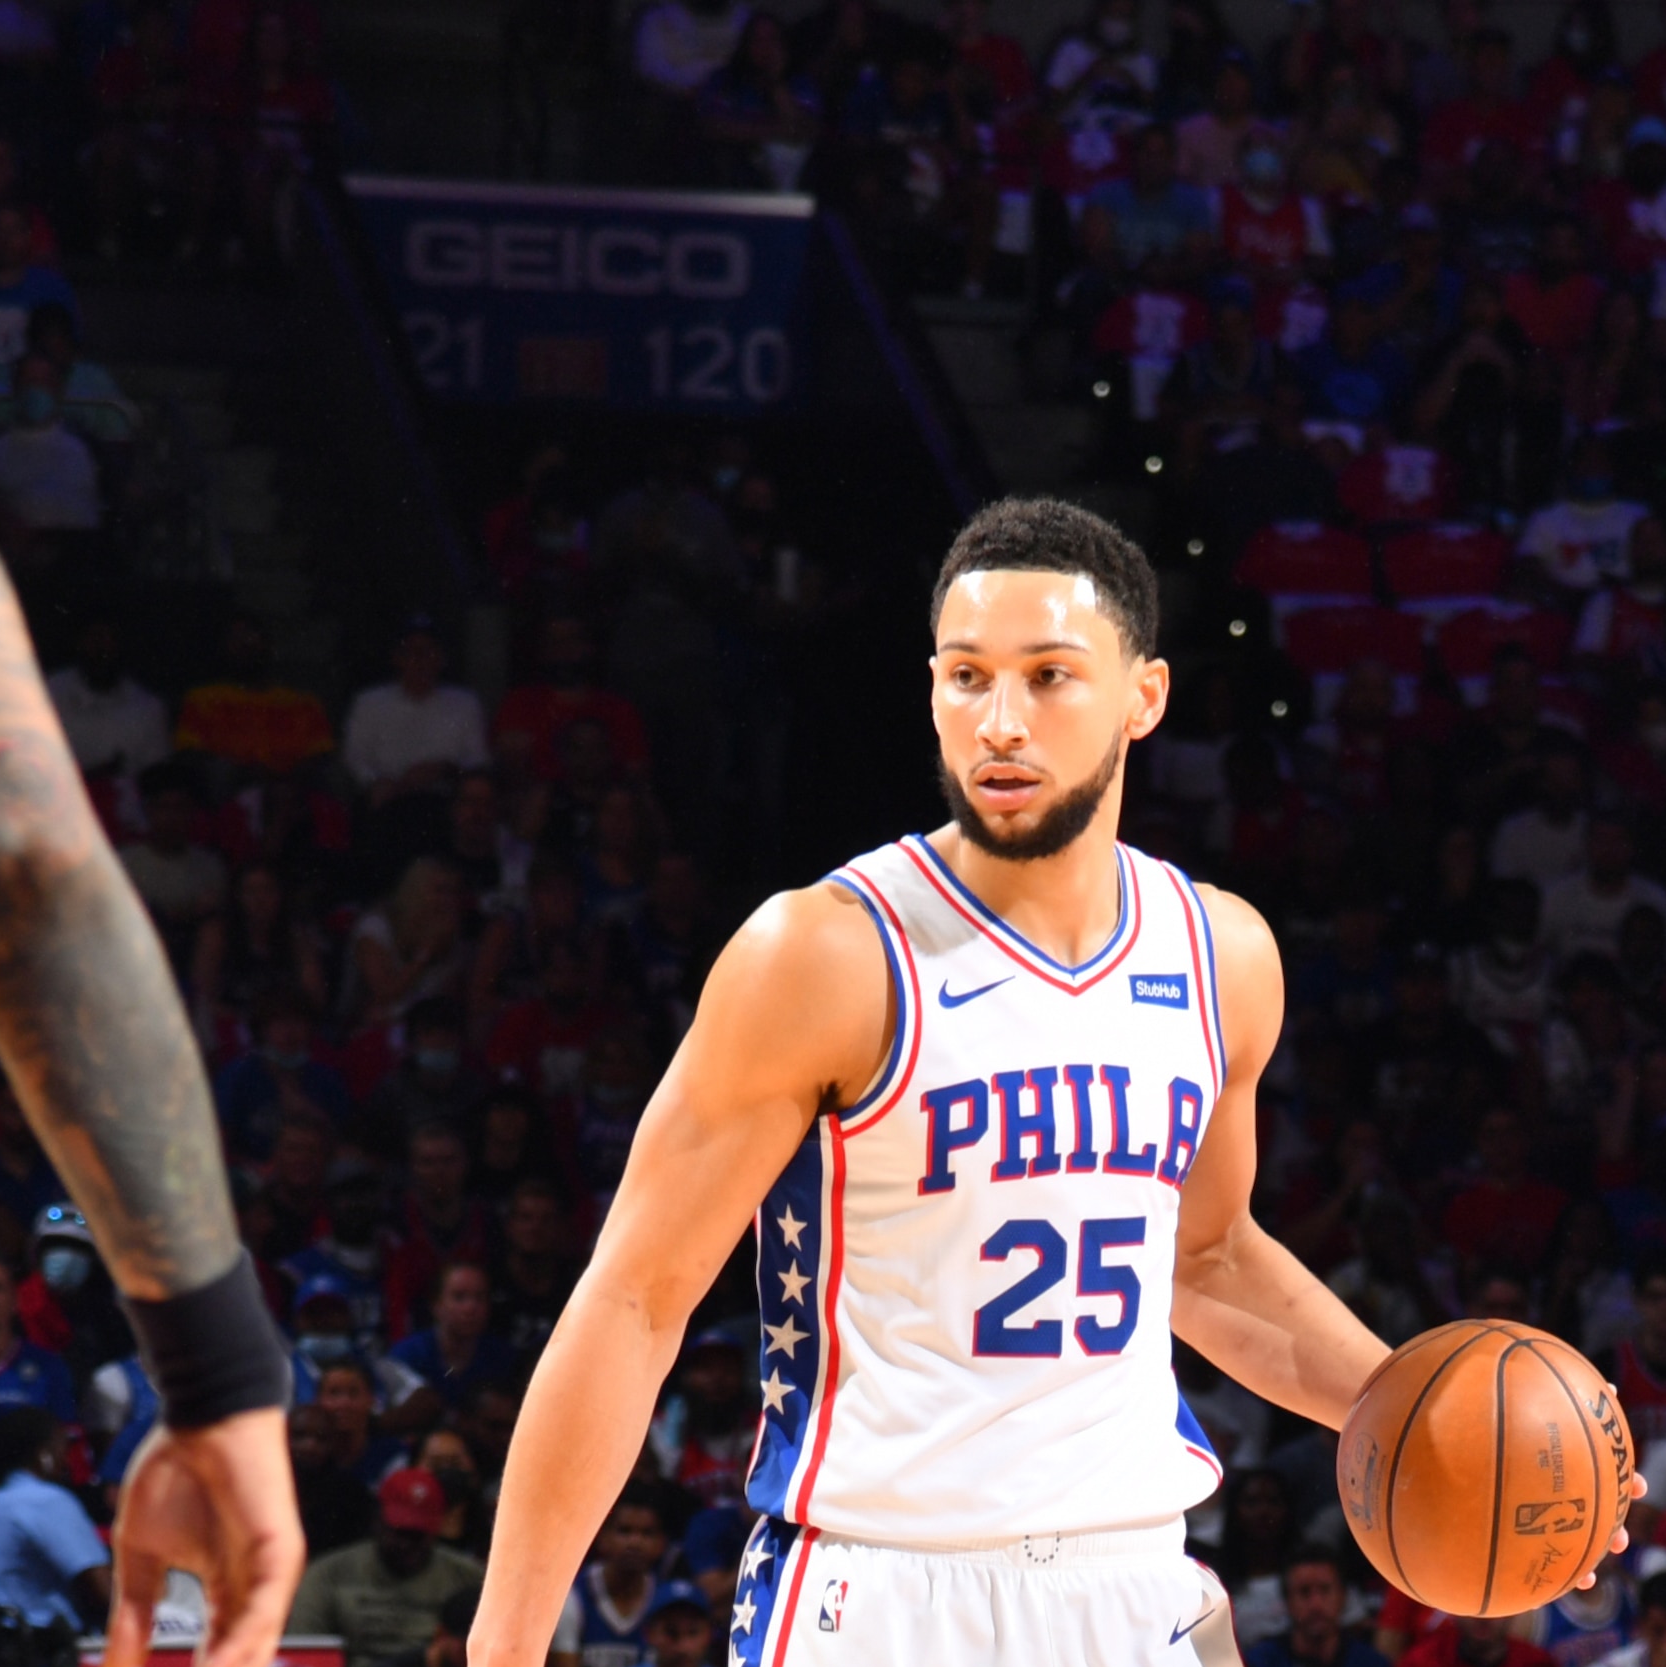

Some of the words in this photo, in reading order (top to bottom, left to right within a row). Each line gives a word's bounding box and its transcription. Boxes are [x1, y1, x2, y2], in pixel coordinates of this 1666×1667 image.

[403, 220, 754, 298] GEICO
[644, 323, 792, 402] 120
[1135, 980, 1181, 999] StubHub
[918, 1062, 1203, 1196] PHILA
[972, 1216, 1147, 1358] 25
[1585, 1390, 1631, 1530] SPALD
